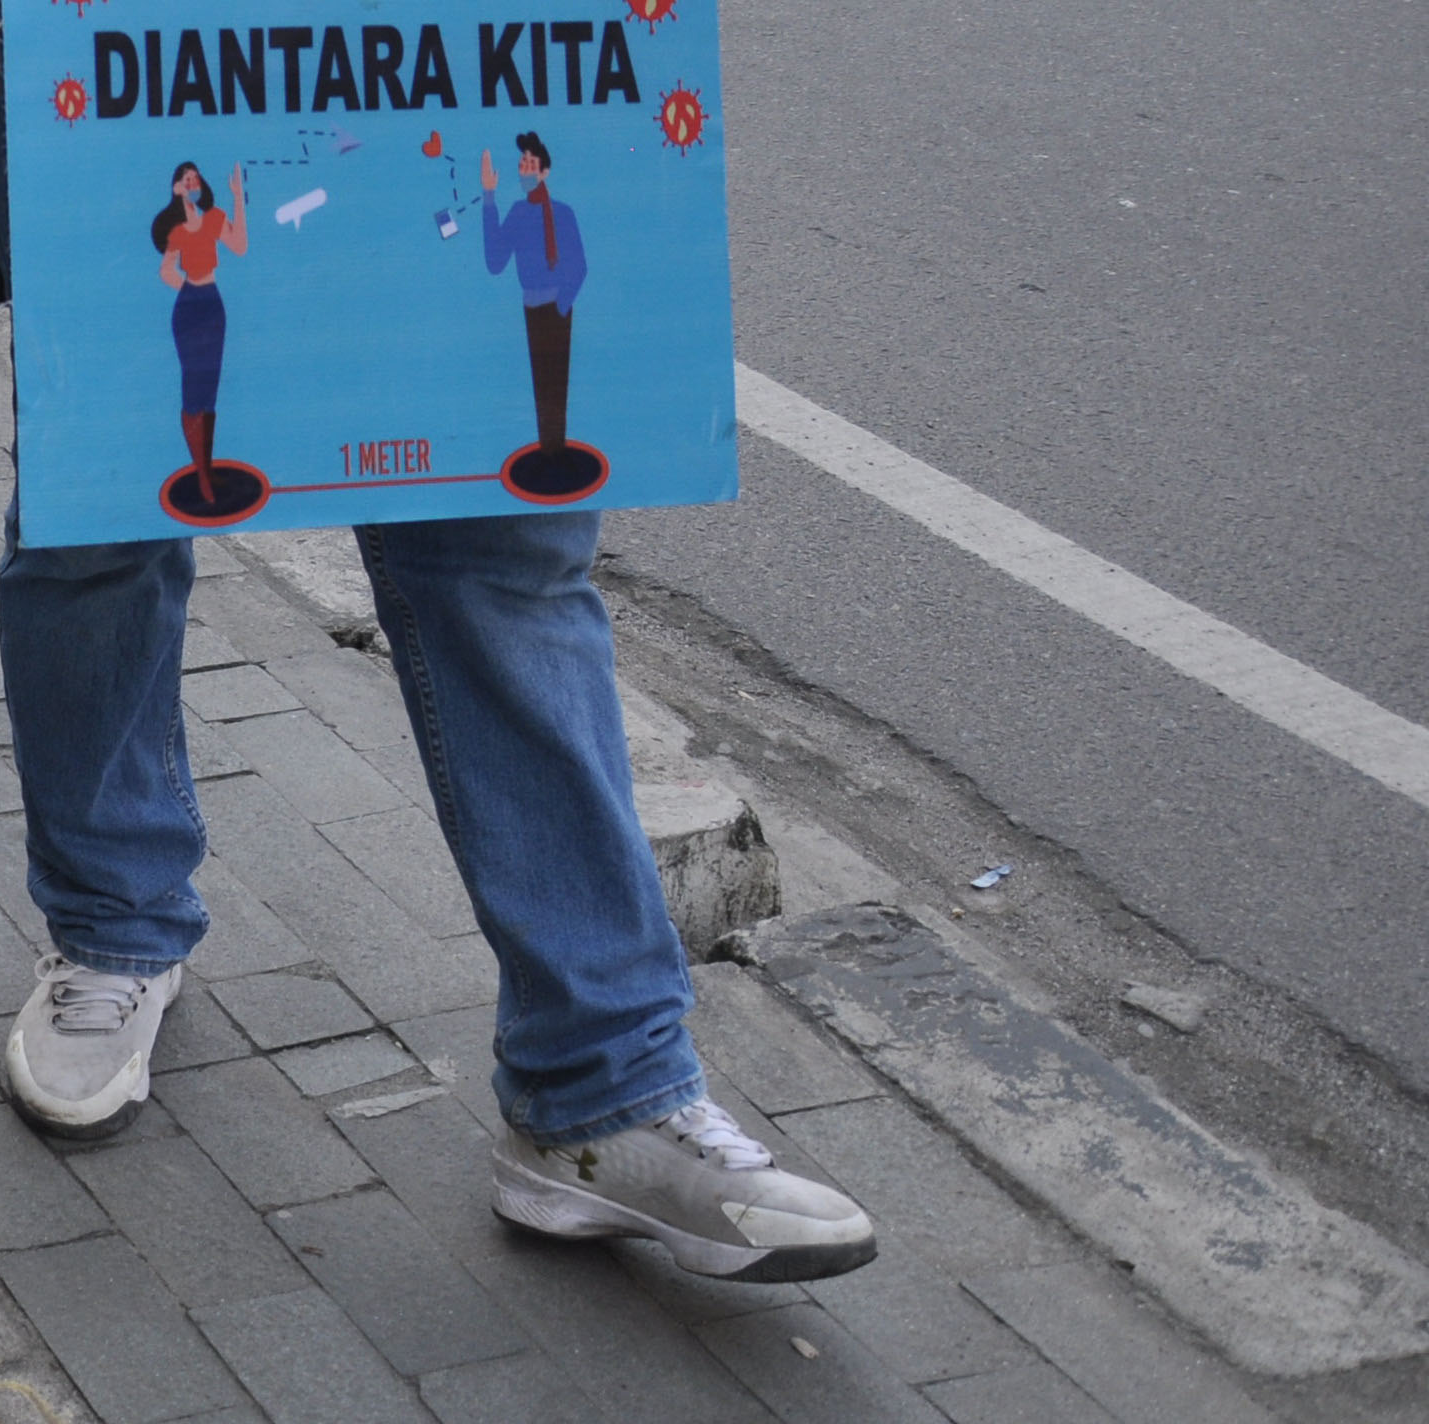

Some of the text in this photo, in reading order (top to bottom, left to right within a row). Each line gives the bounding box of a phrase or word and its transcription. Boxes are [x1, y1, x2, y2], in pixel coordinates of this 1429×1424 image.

[94, 21, 641, 119] DIANTARA KITA
[339, 438, 432, 477] 1 METER
